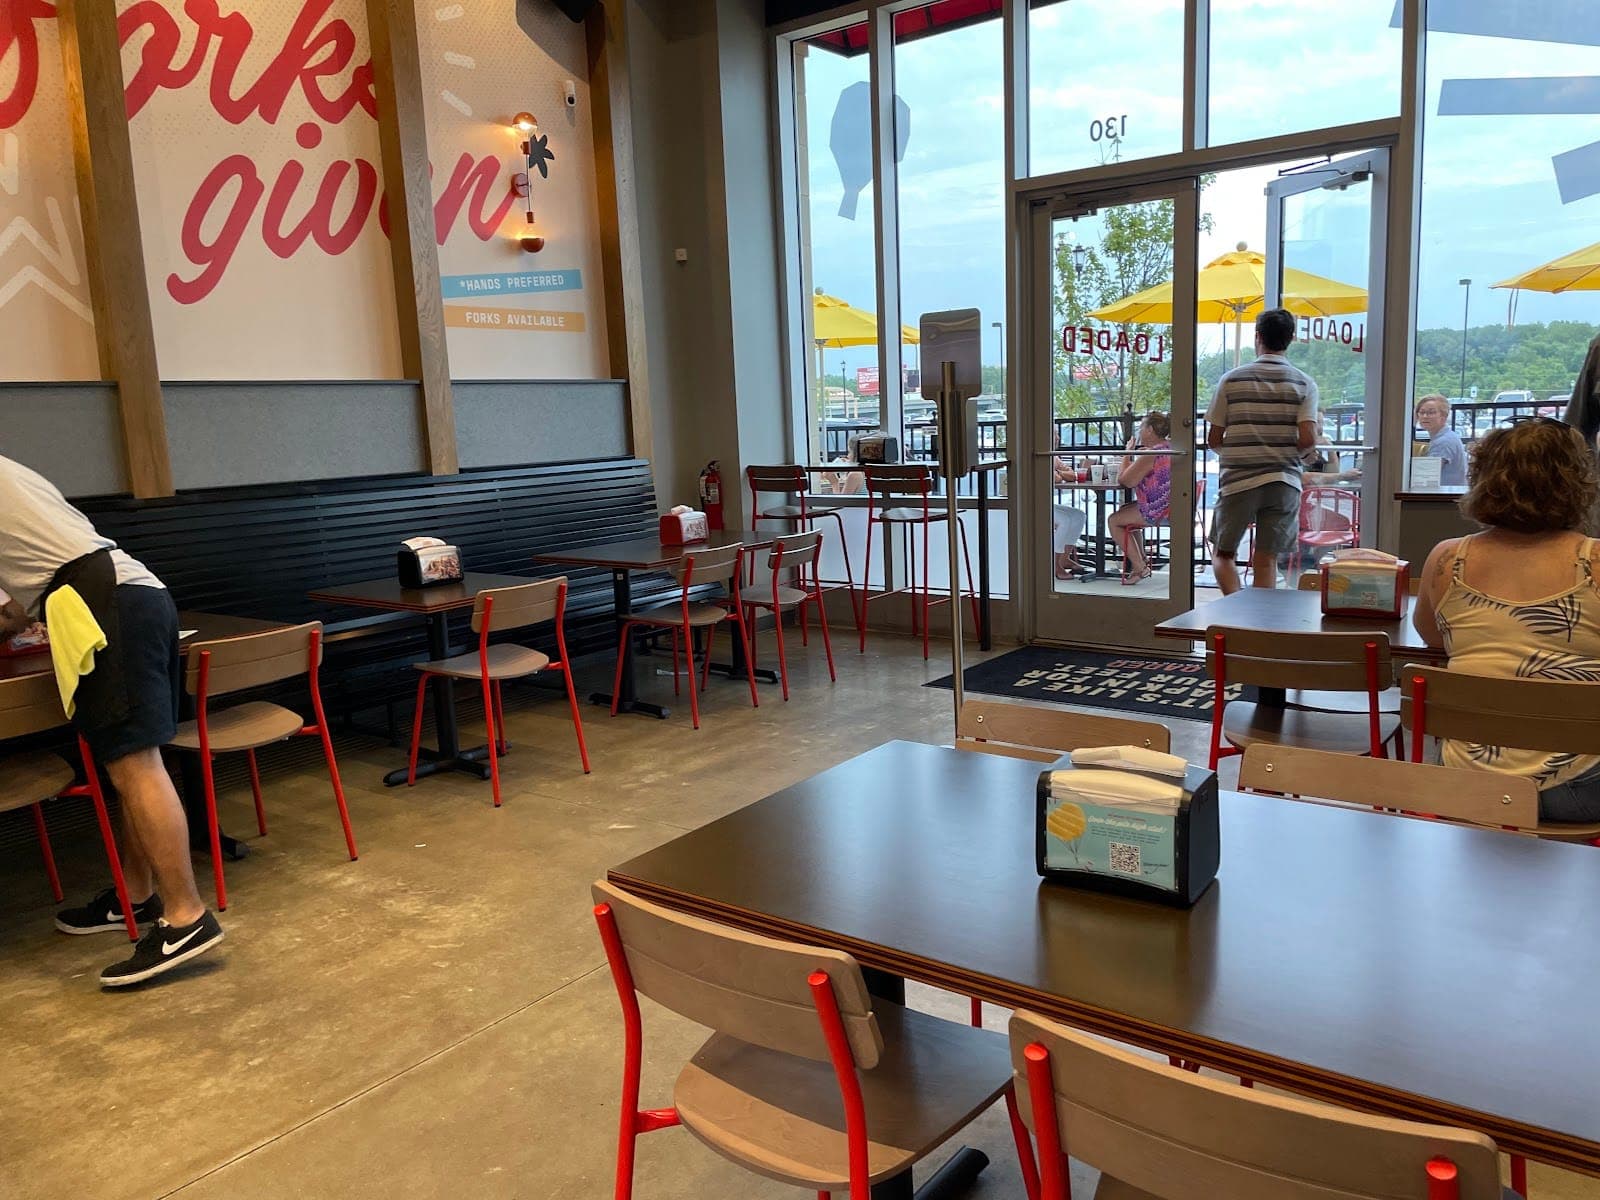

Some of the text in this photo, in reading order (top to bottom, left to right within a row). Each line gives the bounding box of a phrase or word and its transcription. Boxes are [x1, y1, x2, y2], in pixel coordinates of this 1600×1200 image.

[167, 121, 516, 305] givn
[507, 274, 564, 288] PREFERRED
[465, 311, 566, 327] FORKS AVAILABLE
[1053, 663, 1141, 679] FEET.
[1106, 659, 1203, 673] OADED
[1023, 669, 1242, 701] NAPKIN FOR
[1012, 678, 1216, 710] IT'S LIKE A
